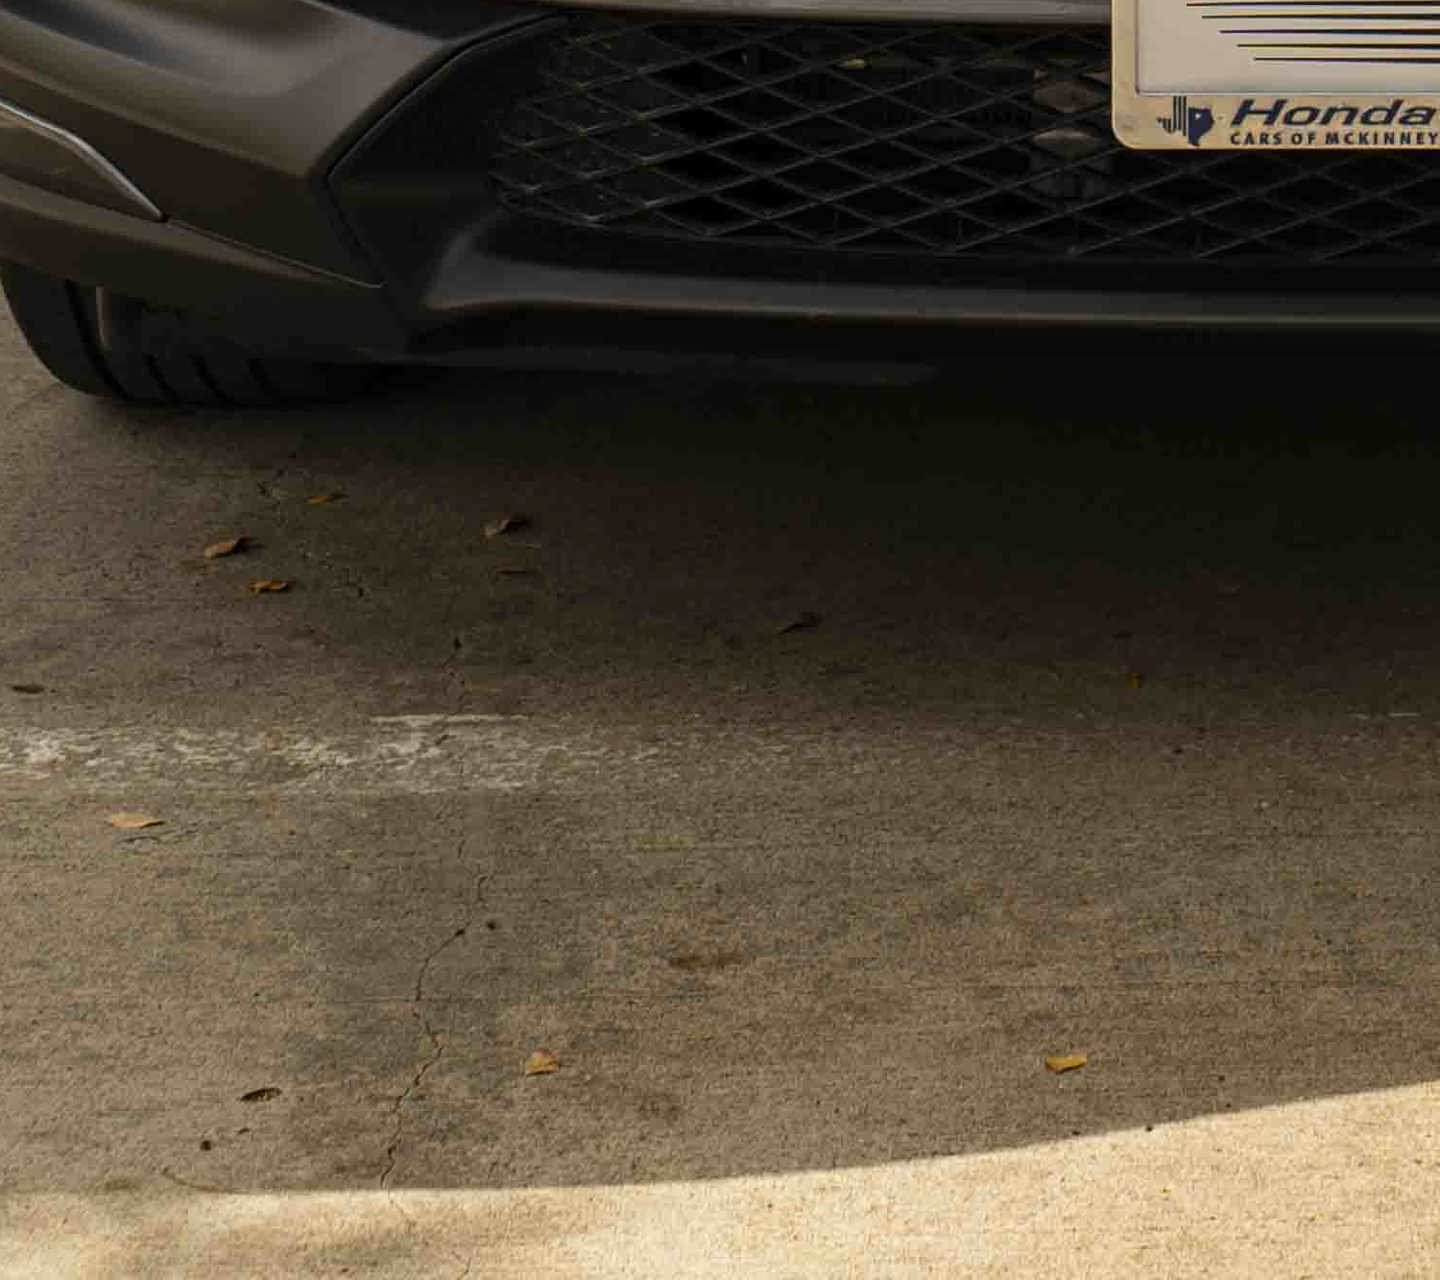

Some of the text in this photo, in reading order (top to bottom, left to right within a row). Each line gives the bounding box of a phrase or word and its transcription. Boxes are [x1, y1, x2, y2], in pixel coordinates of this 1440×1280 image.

[1230, 99, 1438, 126] Honda
[1229, 131, 1439, 146] CARS OF MCKINNEY
